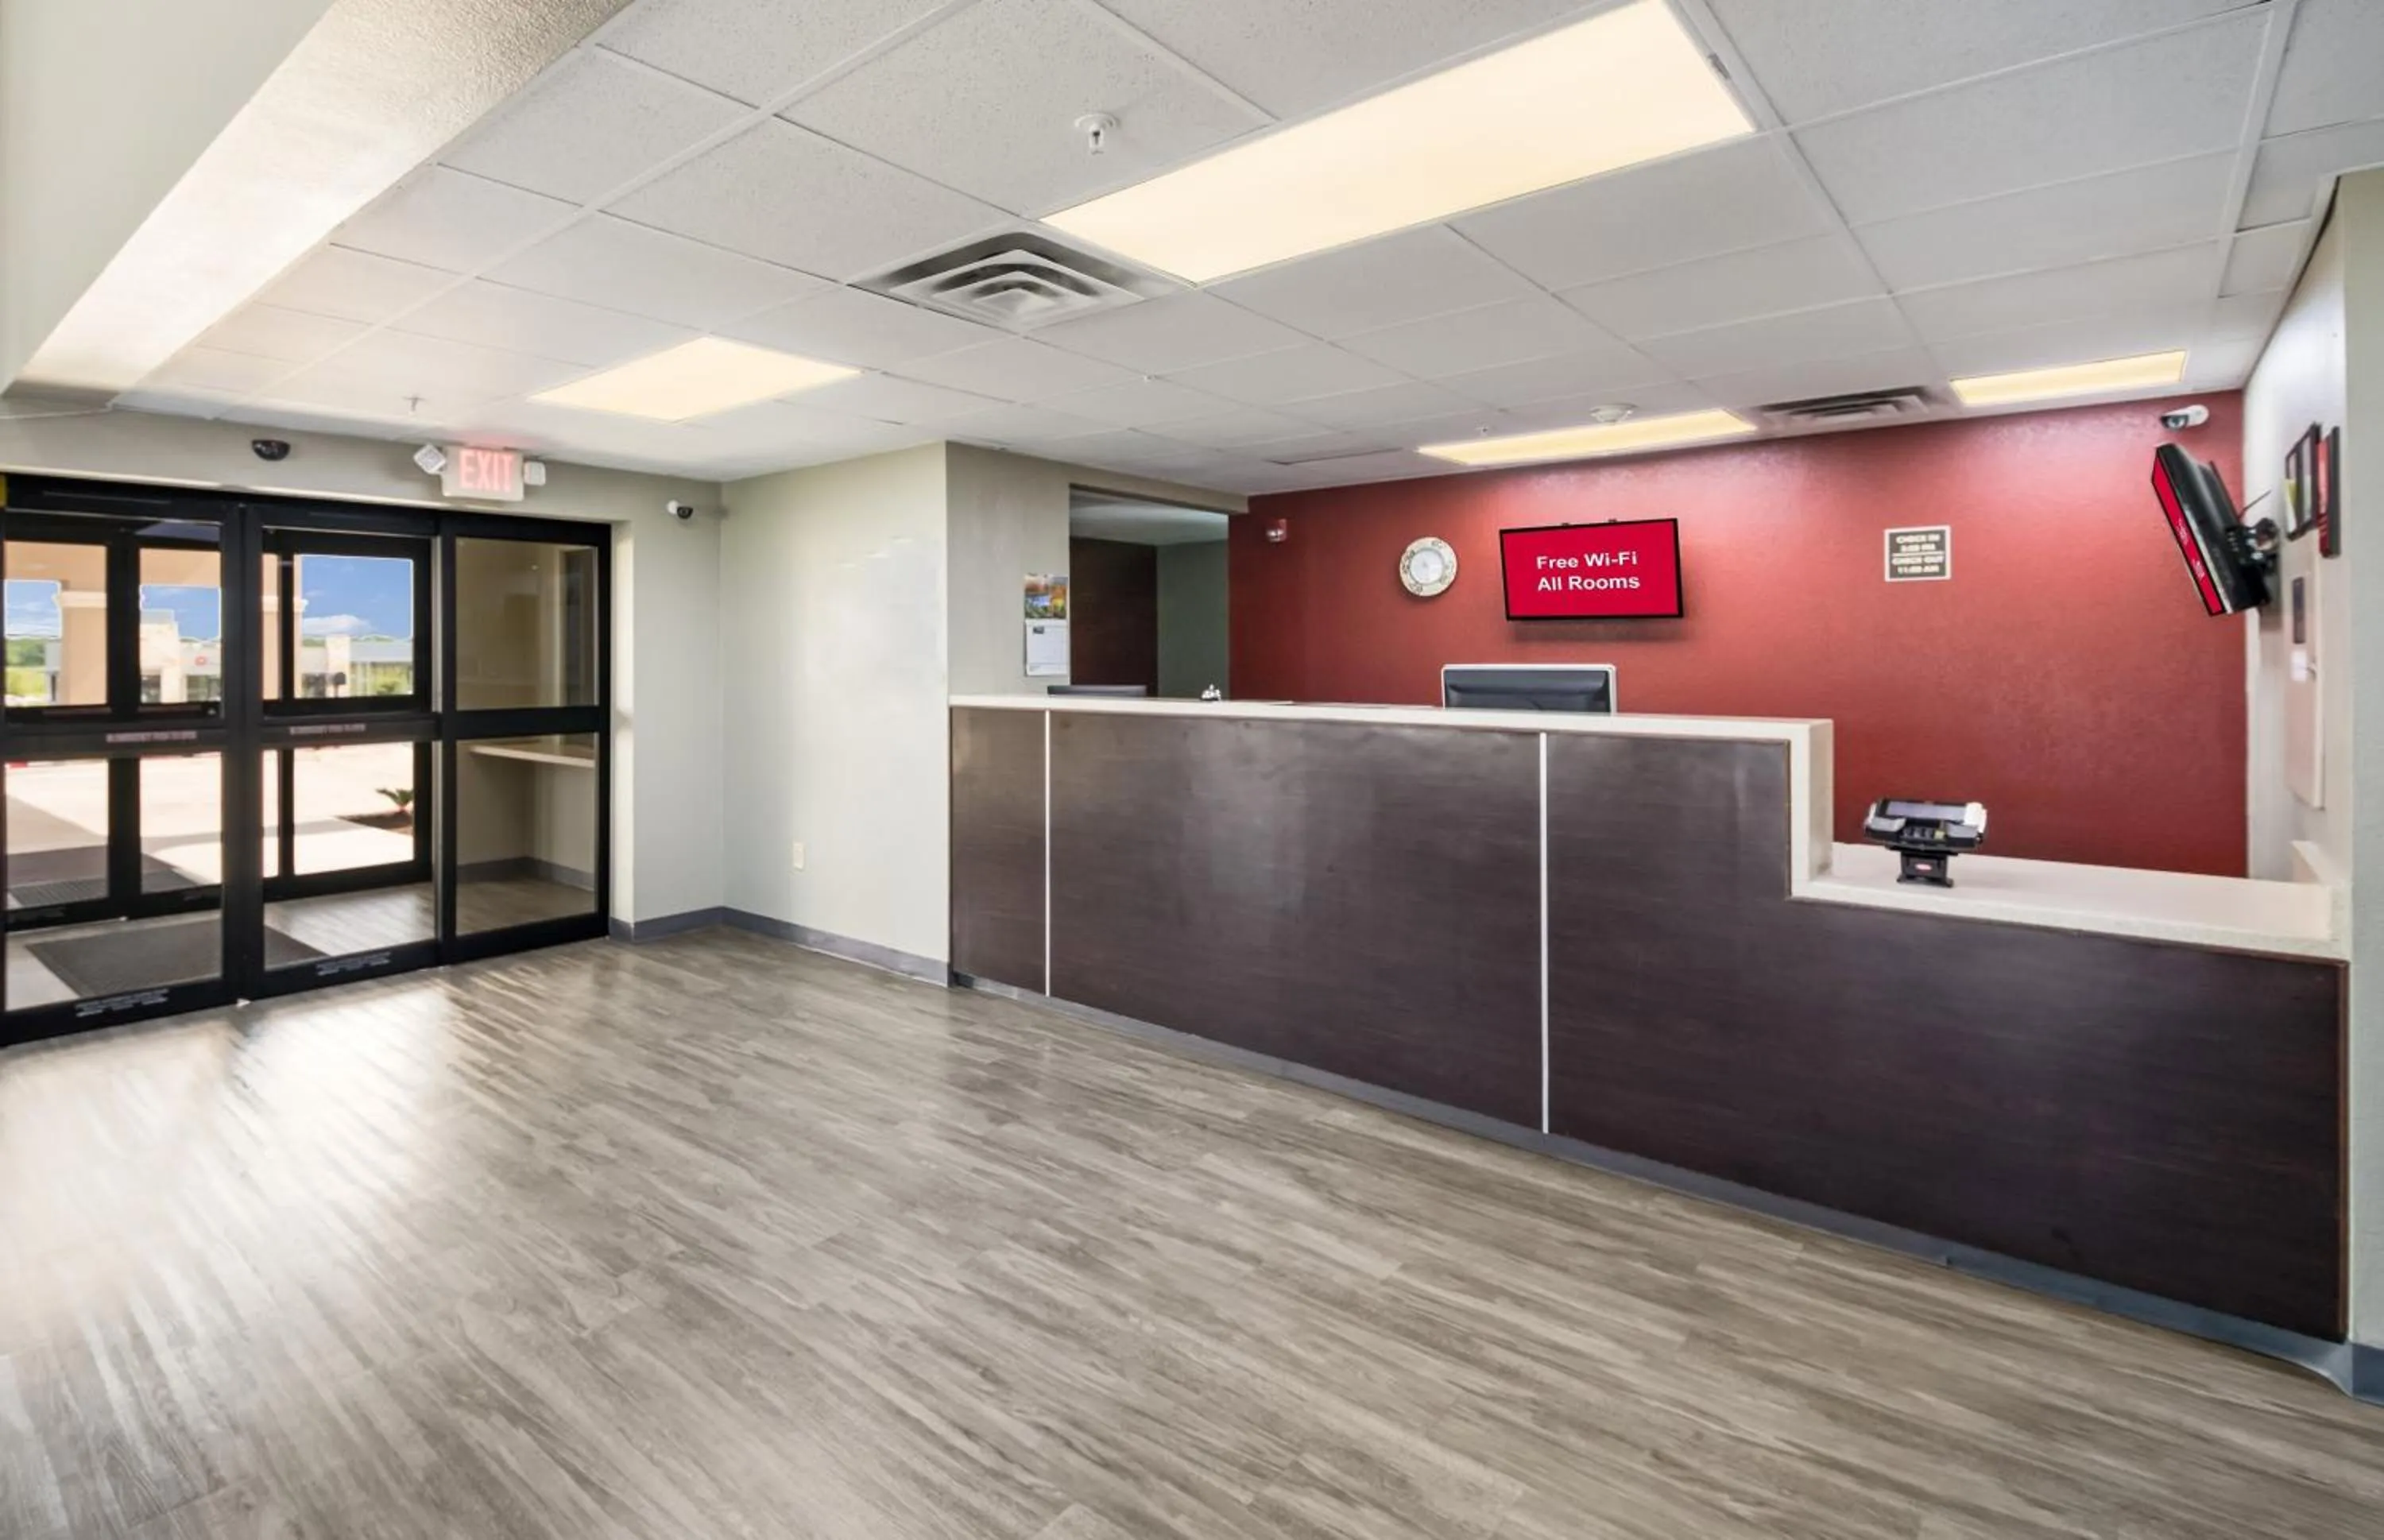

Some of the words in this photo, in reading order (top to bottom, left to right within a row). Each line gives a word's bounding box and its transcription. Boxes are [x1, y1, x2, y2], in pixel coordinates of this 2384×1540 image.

[459, 448, 515, 493] EXIT
[1536, 555, 1579, 570] Free
[1584, 551, 1638, 567] Wi-Fi
[1538, 576, 1562, 591] All
[1568, 575, 1641, 590] Rooms
